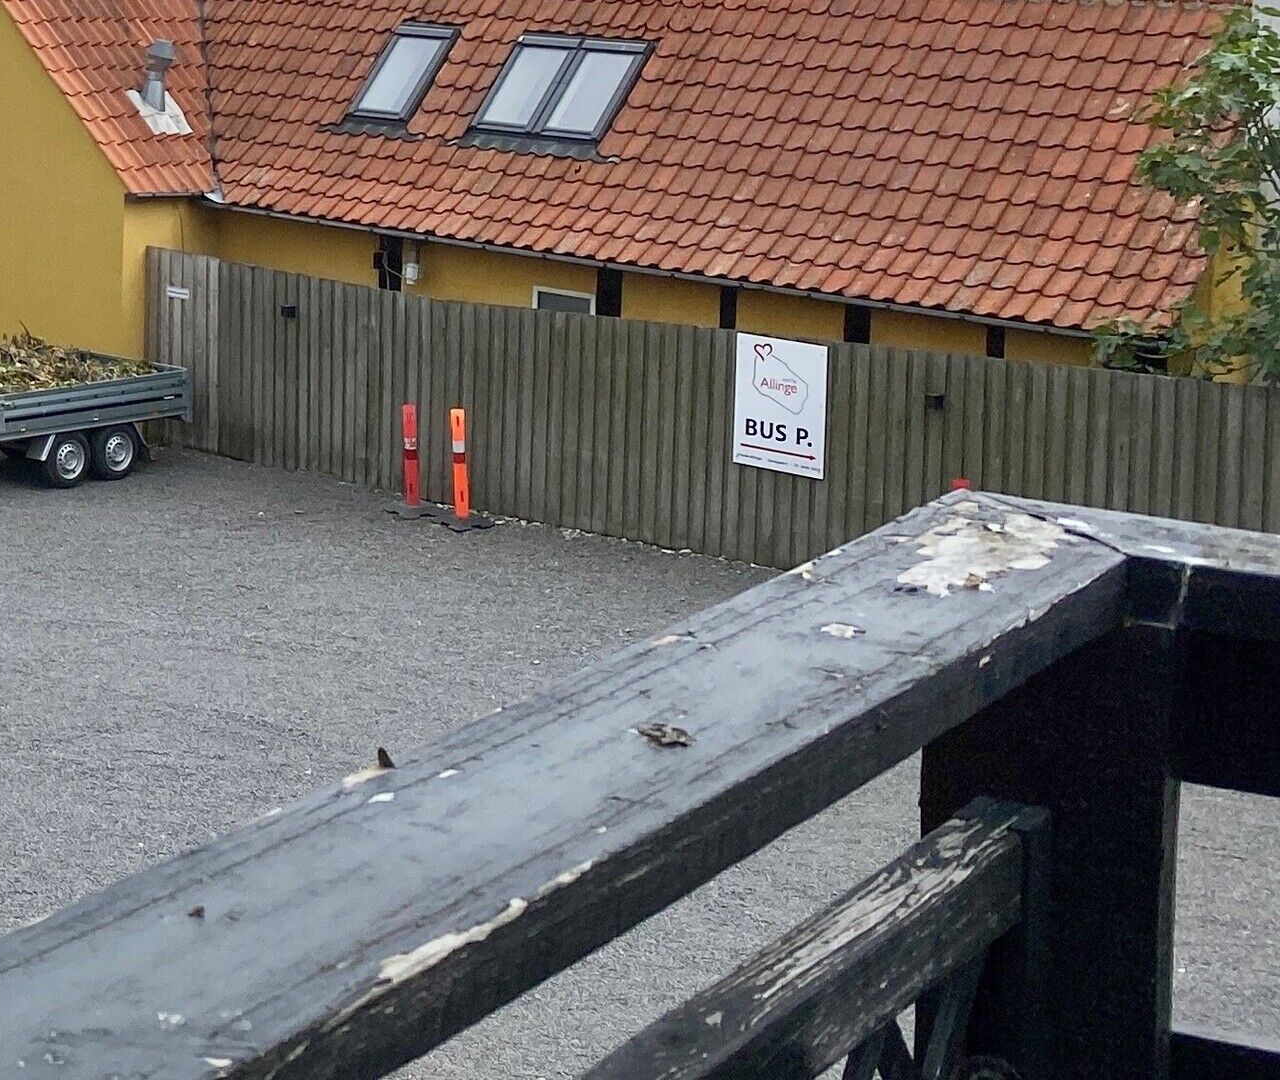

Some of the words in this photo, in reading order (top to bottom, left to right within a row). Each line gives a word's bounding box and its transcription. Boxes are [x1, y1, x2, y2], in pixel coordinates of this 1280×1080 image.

[760, 377, 797, 395] Allinge
[745, 418, 787, 442] BUS
[796, 427, 813, 448] P.
